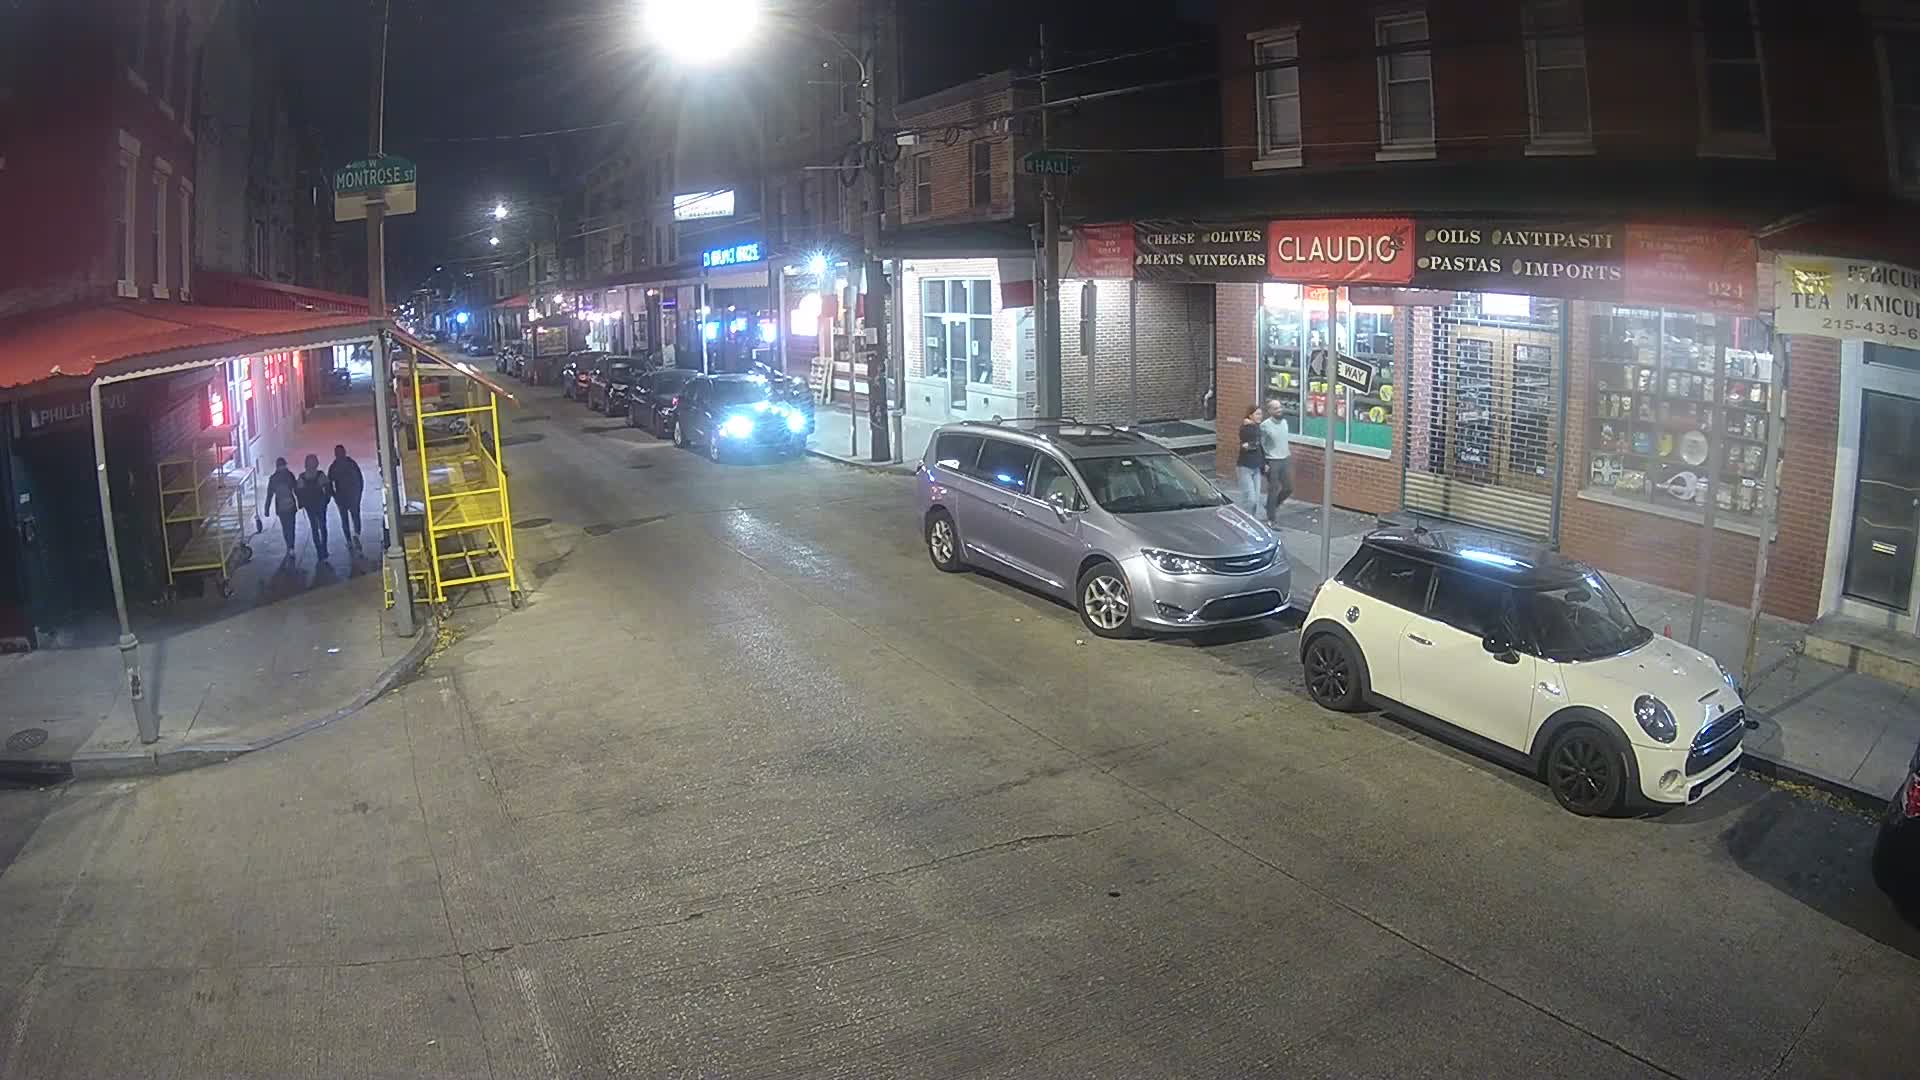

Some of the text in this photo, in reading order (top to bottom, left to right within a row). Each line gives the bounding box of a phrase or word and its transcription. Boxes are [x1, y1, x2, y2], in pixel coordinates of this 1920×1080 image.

[336, 168, 414, 189] MONTROSE ST
[1147, 229, 1261, 245] CHEESE OLIVES
[1436, 229, 1613, 249] OILS ANTIPASTI
[1143, 253, 1266, 266] MEATS VINEGARS
[1429, 256, 1502, 273] PASTAS
[1524, 261, 1622, 281] IMPORTS
[1791, 292, 1830, 310] TEA
[1344, 365, 1365, 382] WAY
